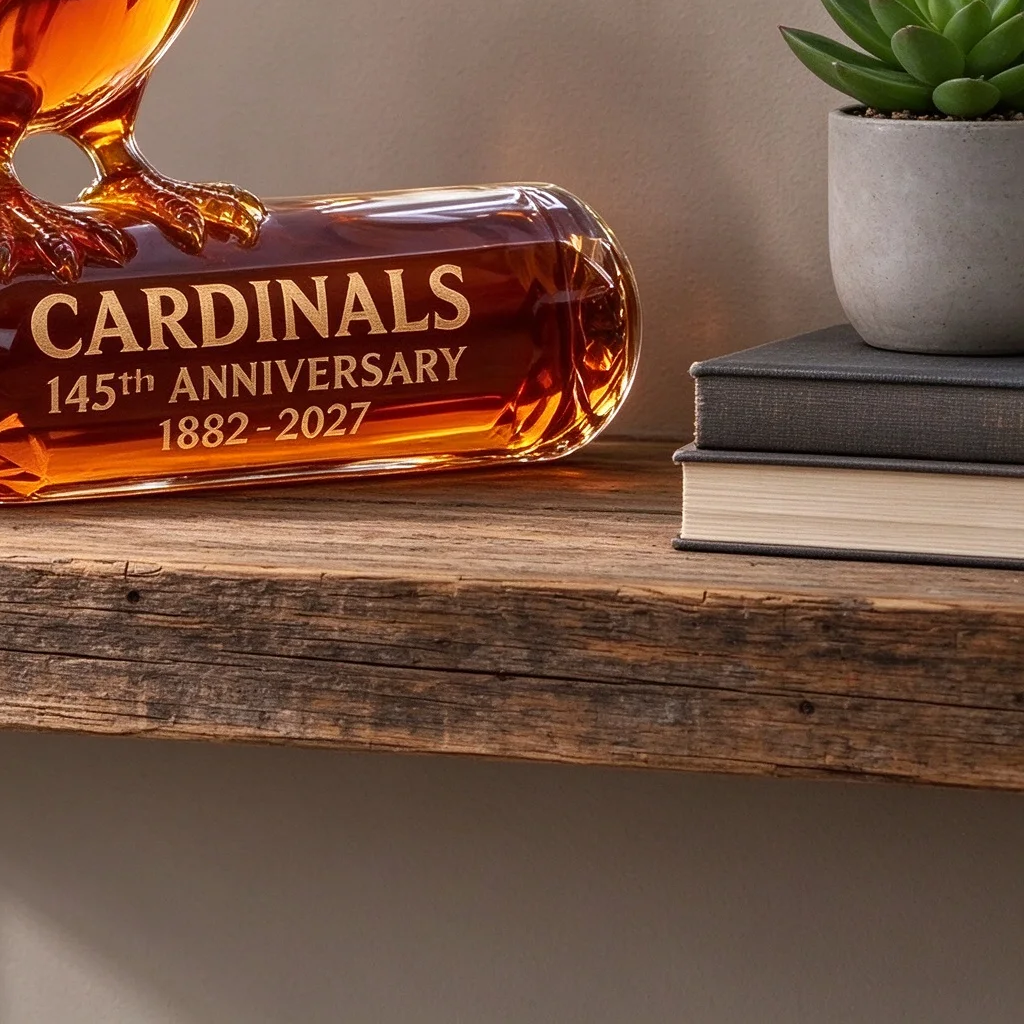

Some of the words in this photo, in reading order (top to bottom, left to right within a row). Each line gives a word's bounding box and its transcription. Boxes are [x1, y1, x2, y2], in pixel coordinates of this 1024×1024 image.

[30, 263, 471, 359] CARDINALS
[47, 368, 155, 414] 145th
[168, 346, 468, 404] ANNIVERSARY
